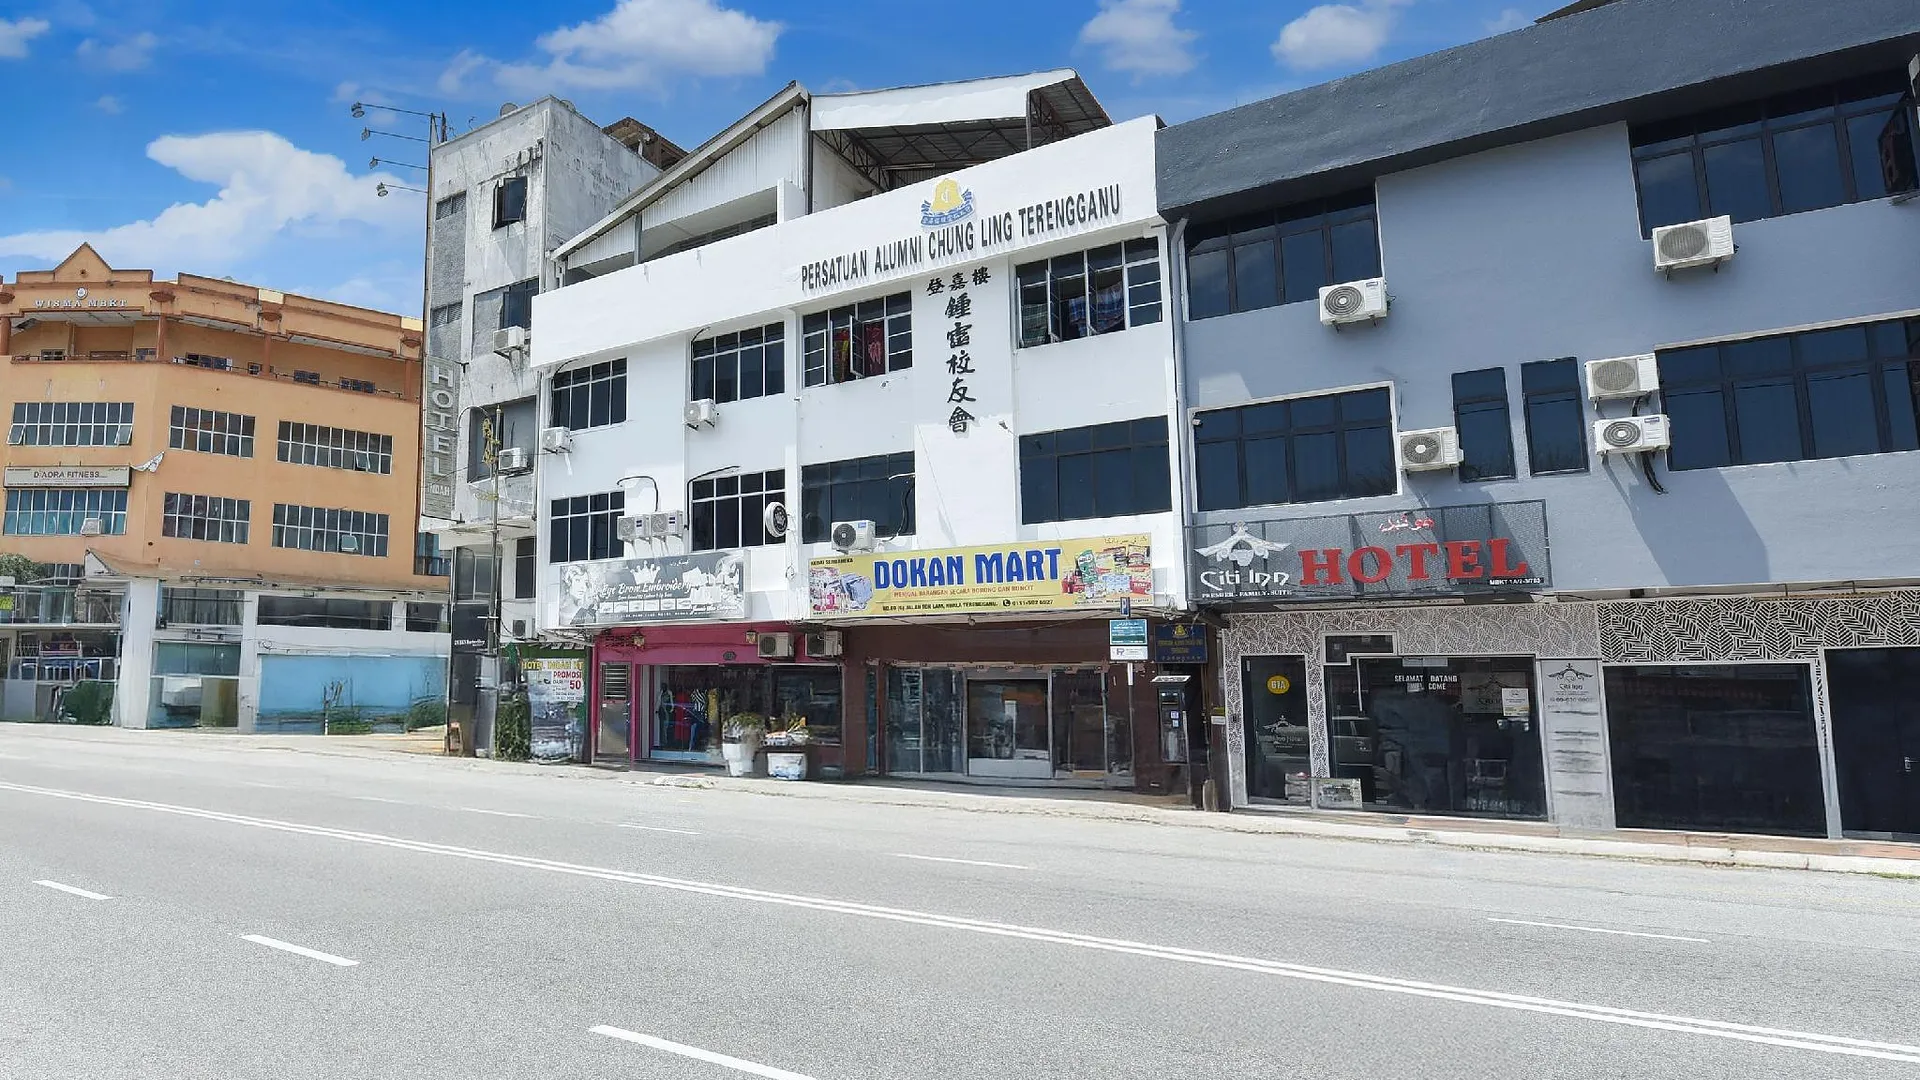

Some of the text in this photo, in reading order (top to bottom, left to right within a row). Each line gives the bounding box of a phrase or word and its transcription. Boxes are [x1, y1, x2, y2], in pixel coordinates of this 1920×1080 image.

[801, 249, 868, 291] PERSATUAN
[874, 235, 922, 274] ALUMNI
[928, 221, 974, 260] CHUNG
[981, 214, 1013, 248] LING
[1018, 184, 1121, 238] TERENGGANU
[926, 266, 992, 297] 登嘉樓
[35, 299, 128, 307] WISMA MBKT
[431, 364, 454, 478] HOTEL
[67, 470, 100, 479] FITNESS
[427, 483, 450, 497] INDAH
[873, 548, 1062, 589] DOKAN MART
[1297, 538, 1528, 586] HOTEL
[642, 578, 692, 595] Embroidery
[1200, 569, 1290, 591] Citi Inn
[553, 670, 582, 679] PROMOSI
[1394, 674, 1424, 682] SELAMAT
[569, 680, 582, 690] 50
